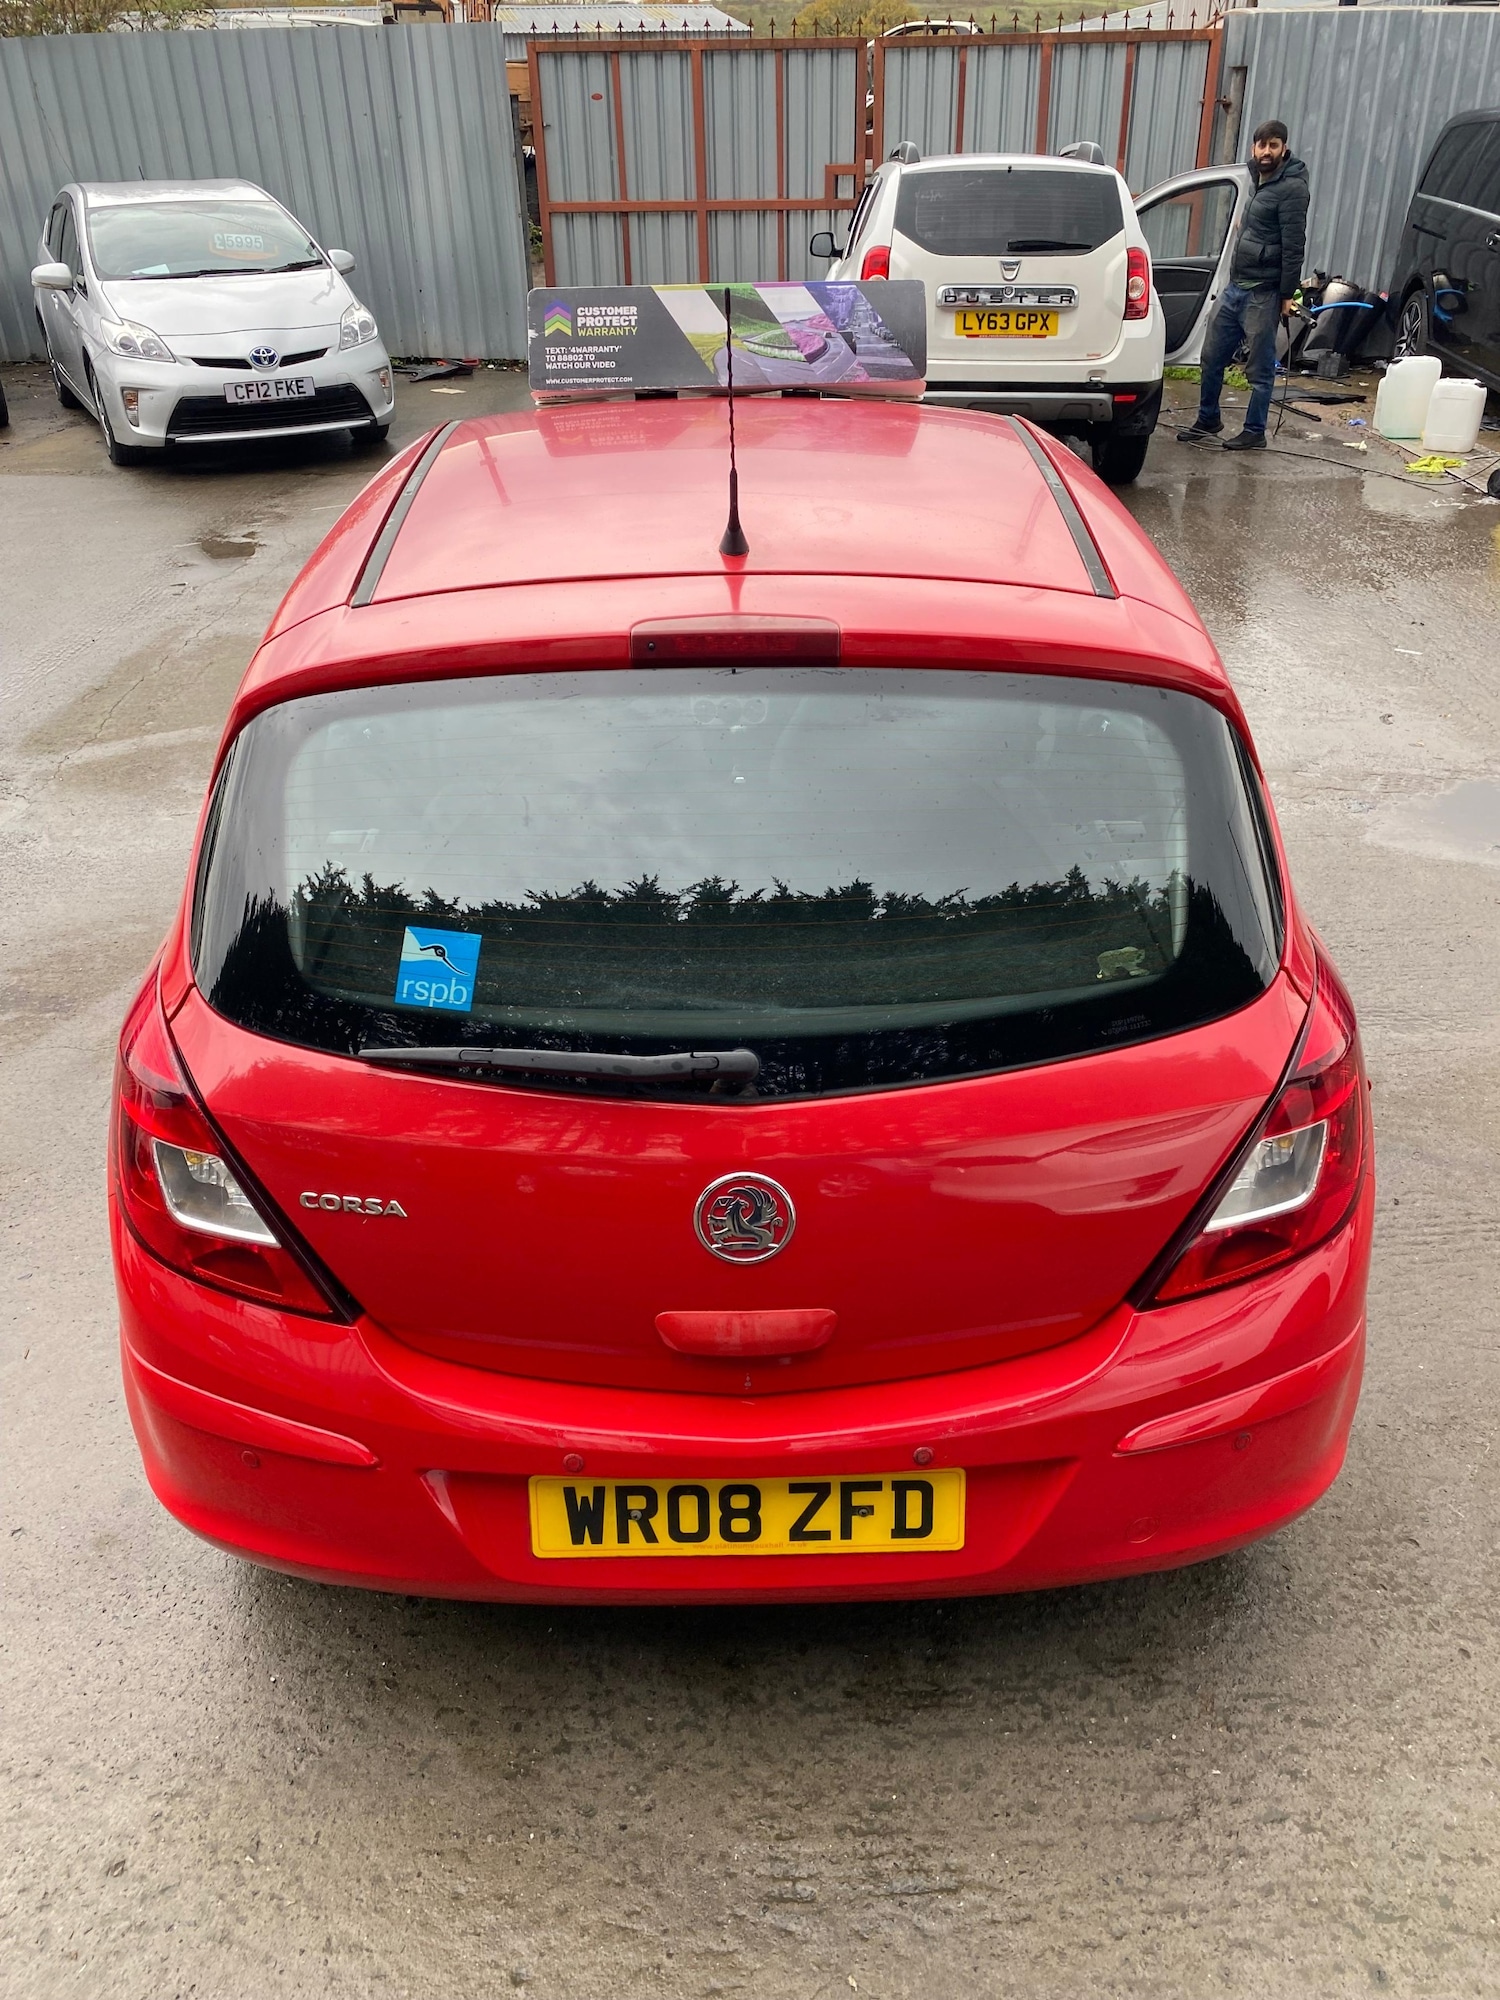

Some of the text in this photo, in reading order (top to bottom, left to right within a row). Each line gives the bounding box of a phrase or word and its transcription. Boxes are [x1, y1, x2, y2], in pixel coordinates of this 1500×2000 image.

[214, 233, 263, 249] £5995
[944, 295, 1073, 304] DUSTER
[577, 306, 637, 316] CUSTOMER
[577, 316, 638, 327] PROTECT
[962, 313, 1050, 331] LY63 GPX
[578, 327, 638, 336] WARRANTY
[234, 380, 306, 400] CF12 FKE
[402, 977, 468, 1008] rspb
[299, 1191, 408, 1218] CORSA
[563, 1480, 934, 1545] WR08 ZFD
